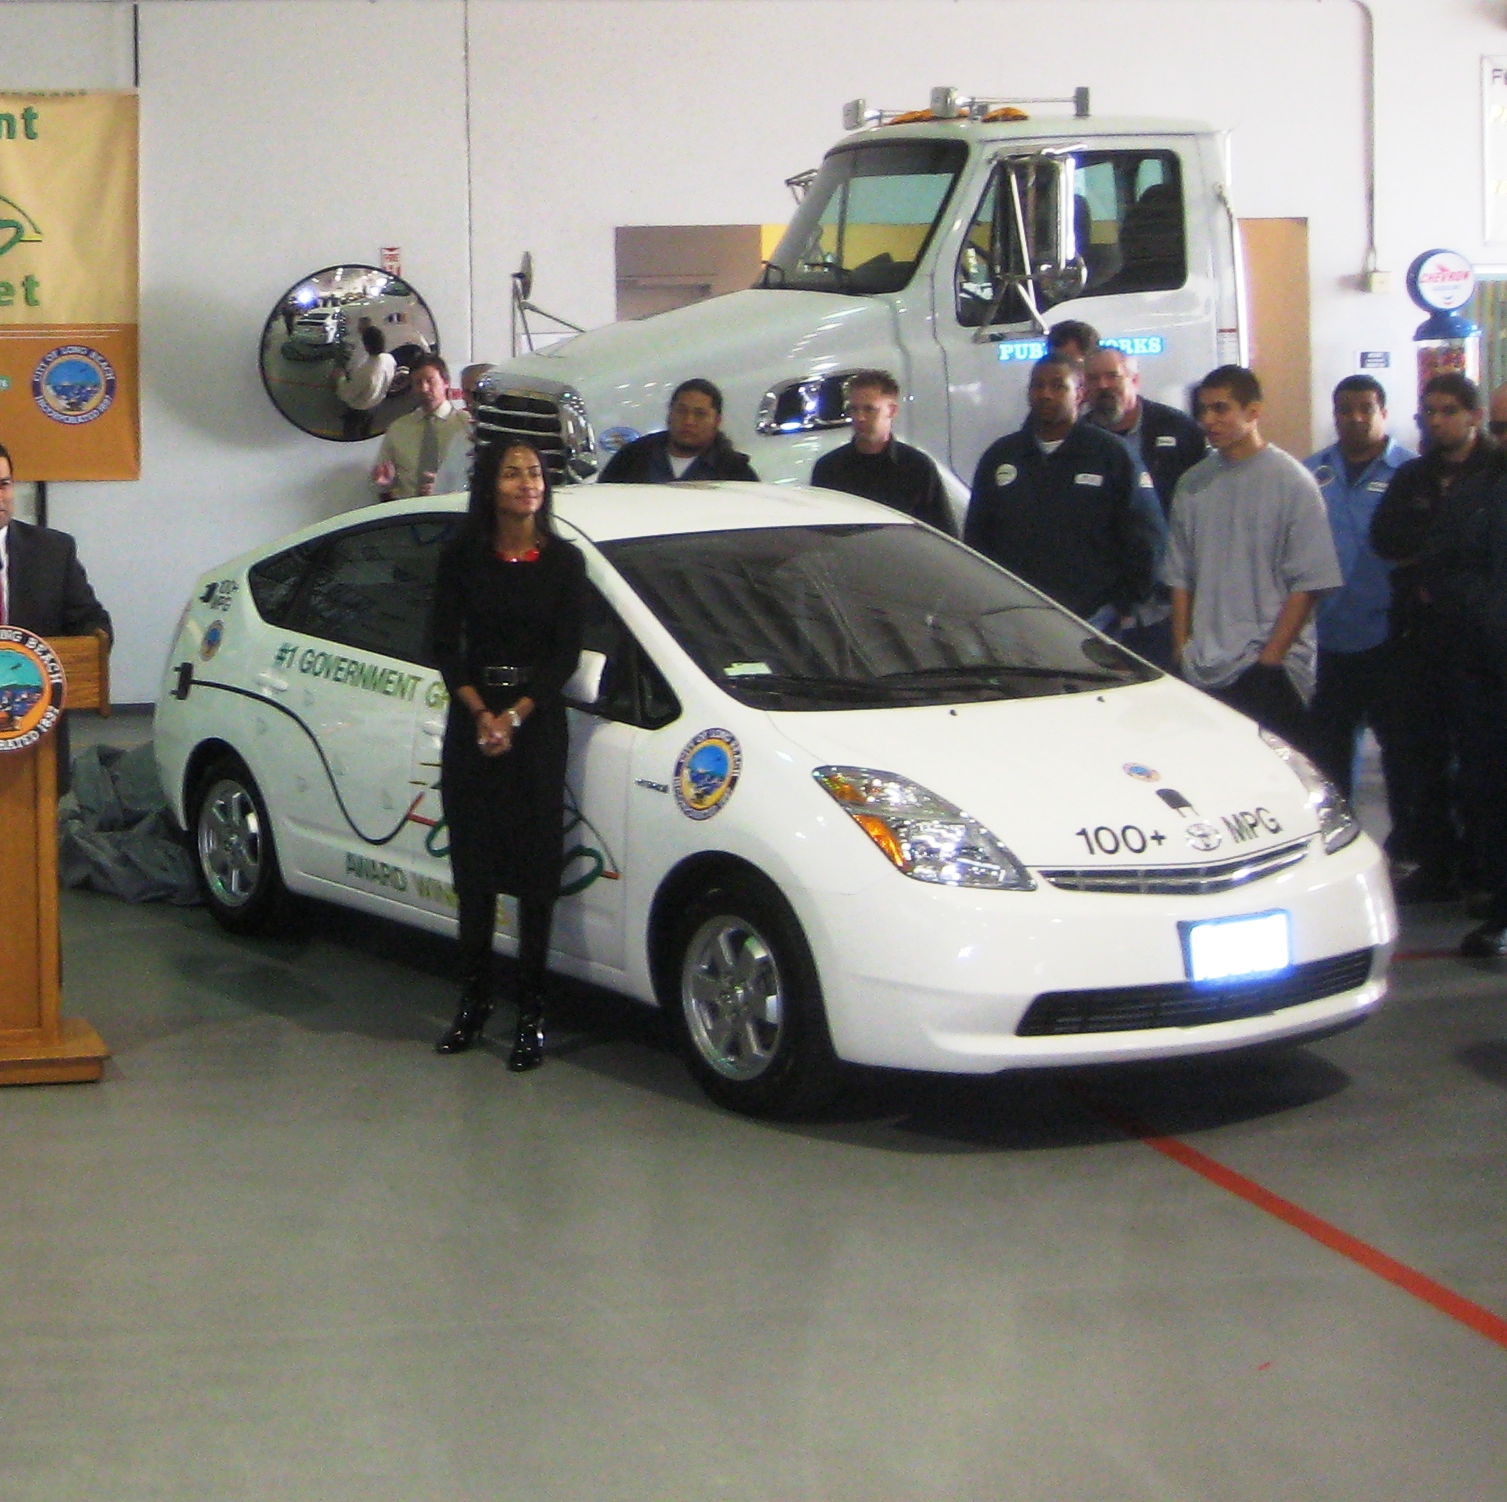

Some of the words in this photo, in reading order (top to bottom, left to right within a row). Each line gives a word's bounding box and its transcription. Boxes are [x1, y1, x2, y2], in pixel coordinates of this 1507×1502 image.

[25, 636, 62, 683] BEACH
[273, 643, 299, 668] #1
[299, 649, 423, 700] GOVERNMENT
[1075, 825, 1167, 855] 100+
[1221, 807, 1283, 844] MPG
[345, 852, 407, 892] AWARD
